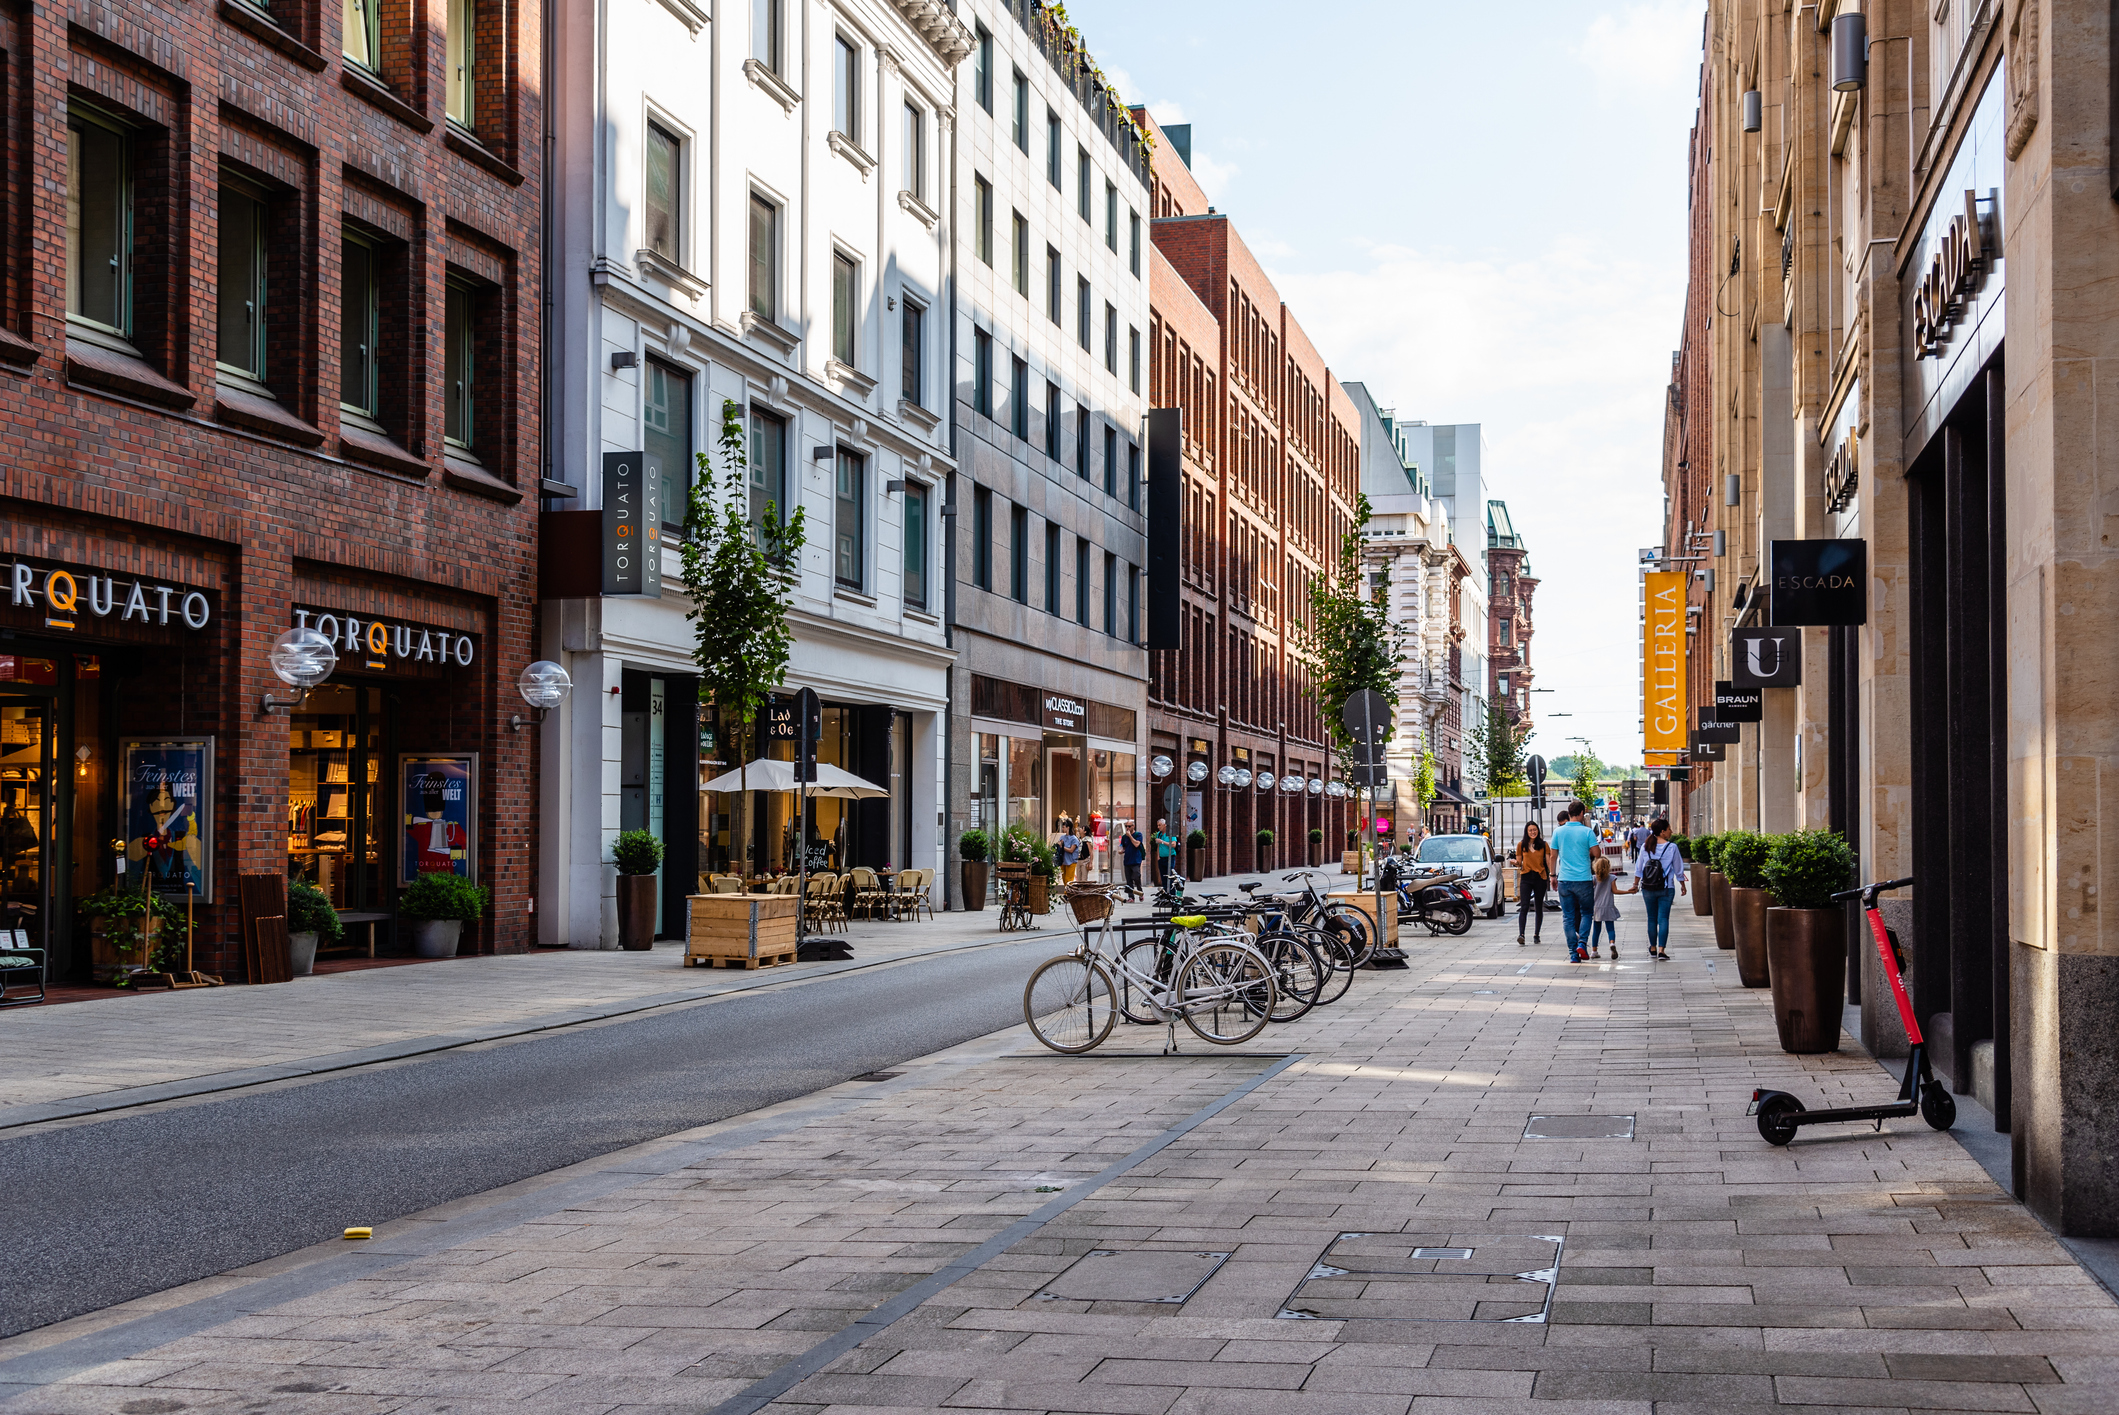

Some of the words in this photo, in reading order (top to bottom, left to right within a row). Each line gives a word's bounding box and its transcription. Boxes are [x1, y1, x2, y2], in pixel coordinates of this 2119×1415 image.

[1913, 189, 1982, 361] ESCADA
[617, 463, 632, 582] TORQUATO
[648, 466, 657, 583] TORQUATO
[1778, 575, 1855, 589] ESCADA
[11, 562, 209, 630] RQUATO
[294, 608, 473, 668] TORQUATO
[1654, 585, 1677, 735] GALLERIA
[652, 700, 663, 715] 34
[1717, 695, 1759, 704] BRAUN
[133, 764, 196, 783] Feinstes
[409, 773, 463, 789] Feinstes
[172, 783, 196, 797] WELT
[442, 789, 461, 801] WELT
[415, 860, 457, 868] TORQUATO
